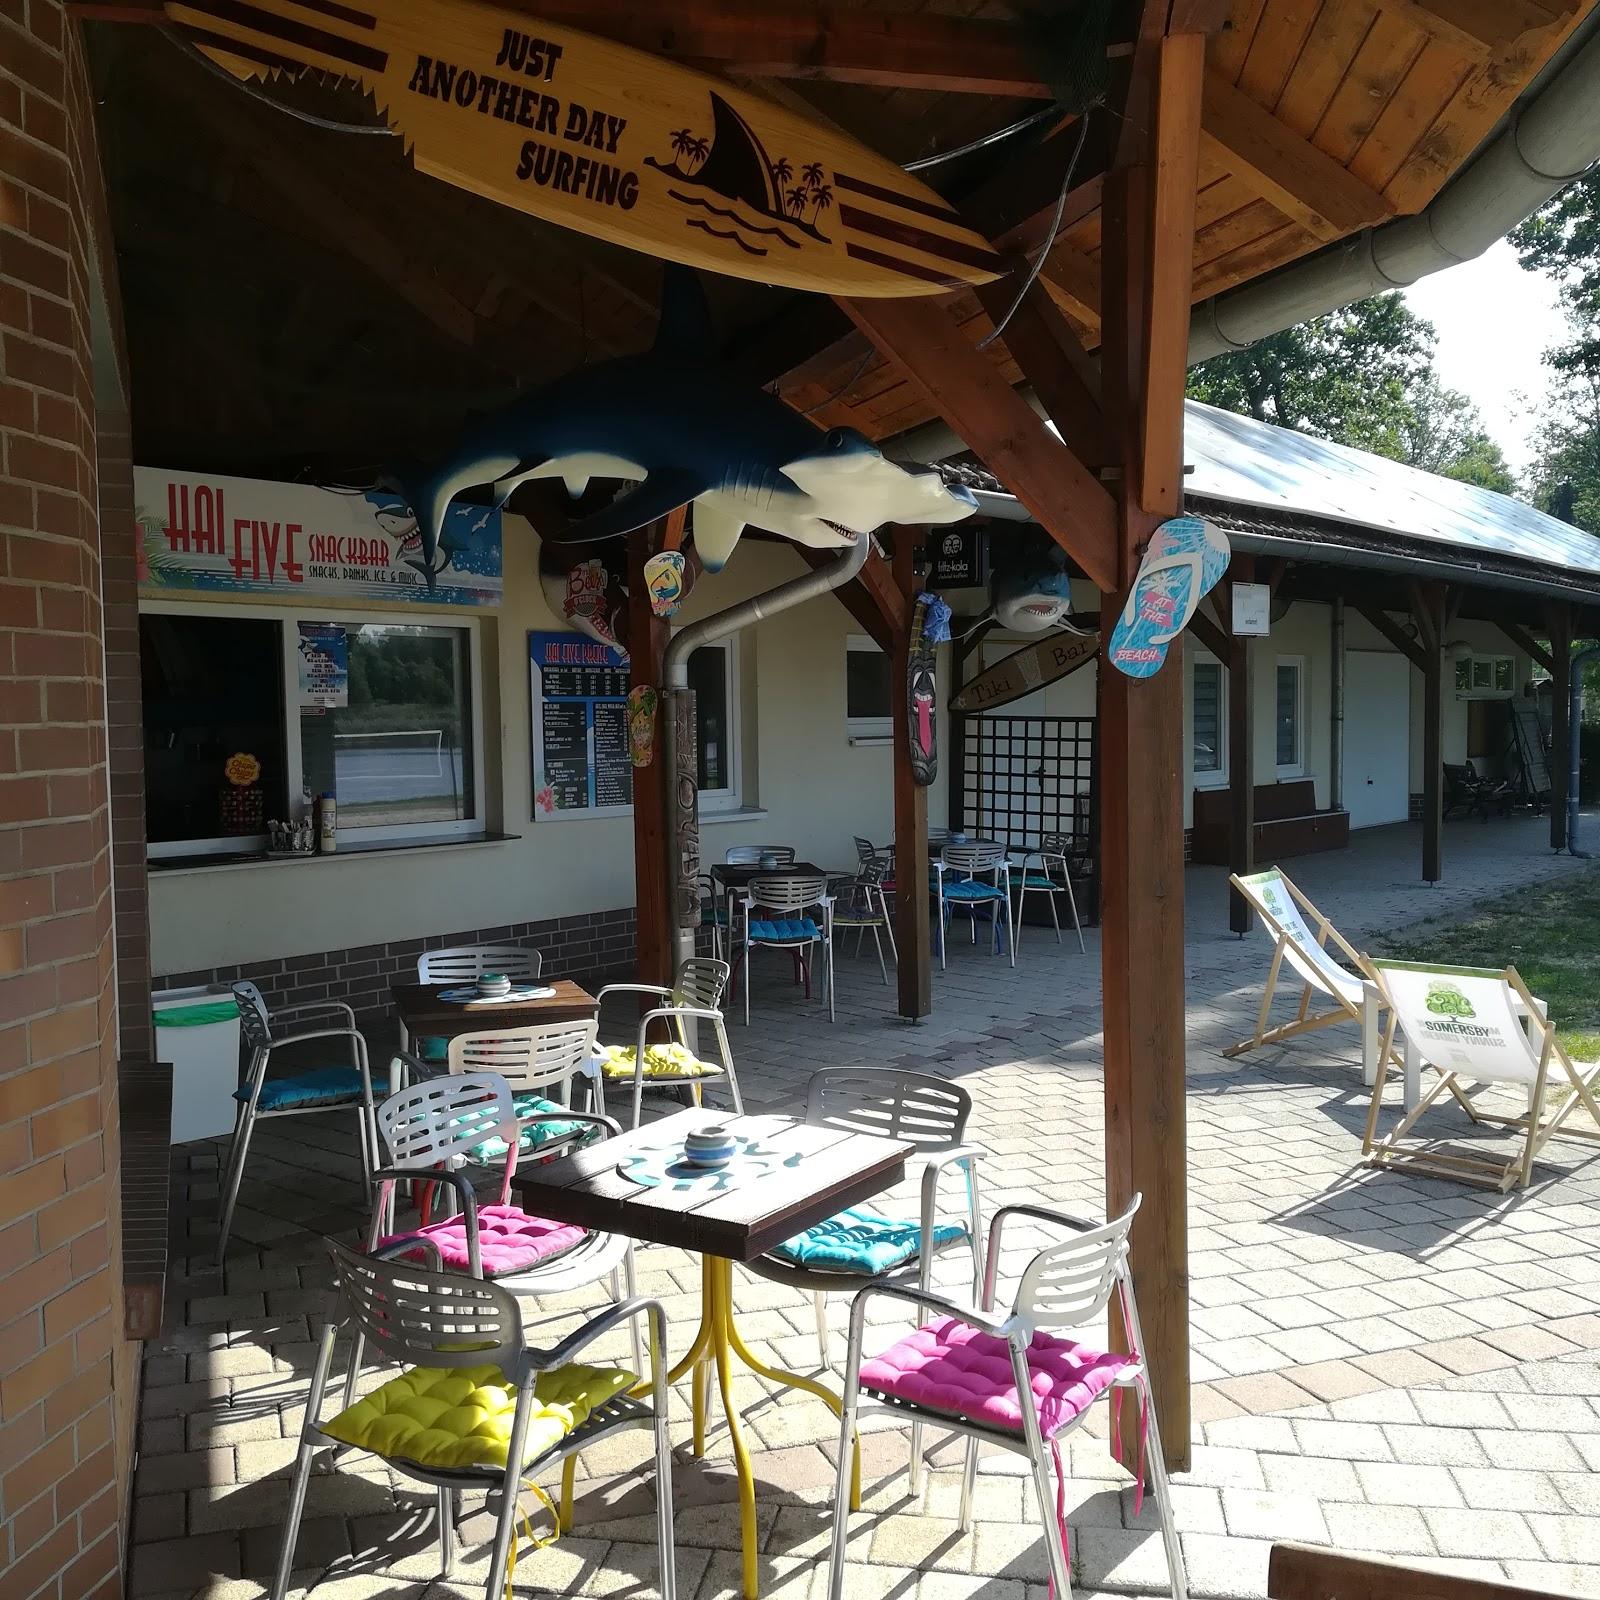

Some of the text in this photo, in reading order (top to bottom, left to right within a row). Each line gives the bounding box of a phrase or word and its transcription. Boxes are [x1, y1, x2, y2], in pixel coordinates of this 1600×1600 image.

[496, 28, 563, 82] JUST
[408, 55, 627, 154] ANOTHER DAY
[516, 140, 639, 210] SURFING
[162, 483, 304, 584] HAI FIVE
[308, 533, 390, 567] SNACKBAR
[374, 570, 386, 582] ICE
[1143, 607, 1166, 623] THE
[1153, 597, 1172, 608] AT
[971, 640, 1089, 703] Tiki Bar
[1117, 648, 1158, 661] BEACH
[1425, 1020, 1490, 1037] SOMERSBY
